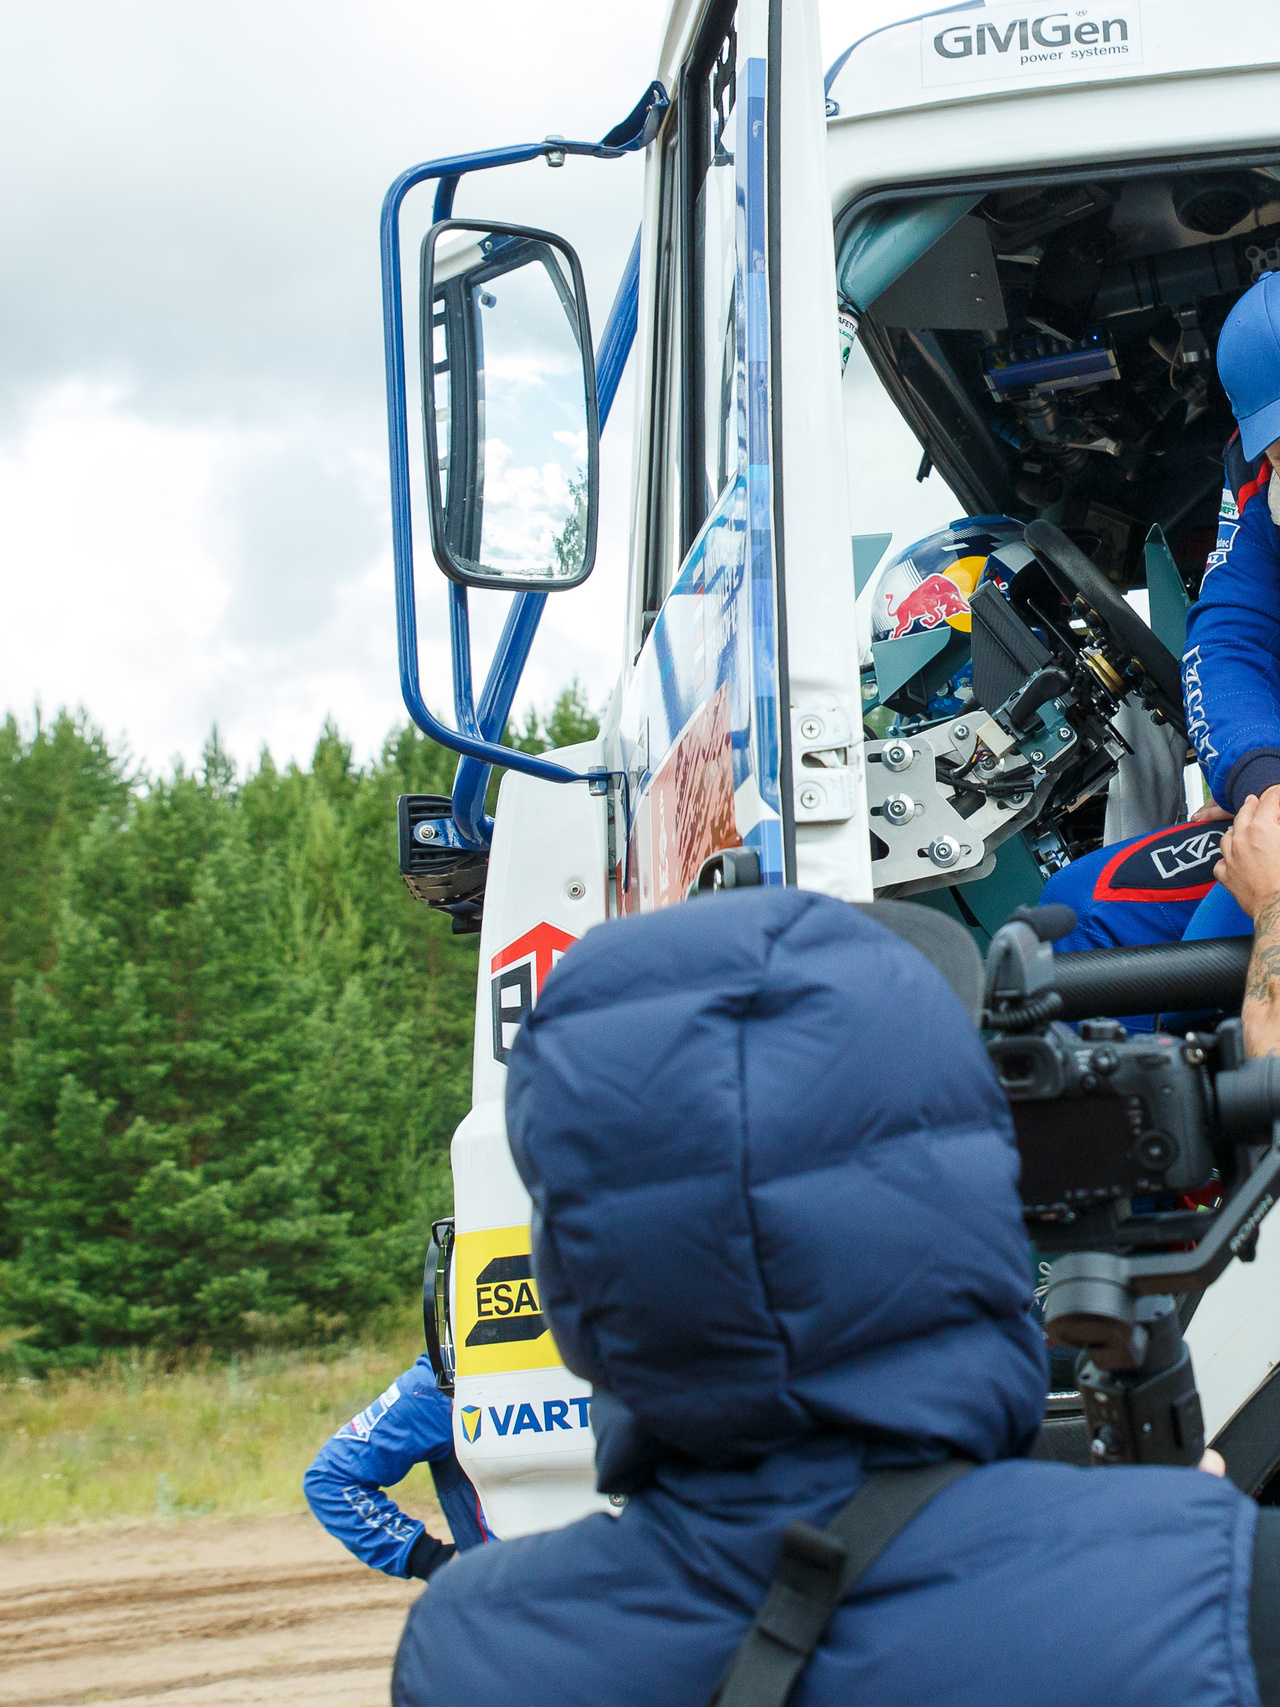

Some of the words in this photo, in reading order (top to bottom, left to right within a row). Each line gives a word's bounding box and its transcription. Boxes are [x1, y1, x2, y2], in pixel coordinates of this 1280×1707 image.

[1020, 51, 1064, 66] power
[1071, 44, 1129, 60] systems
[476, 1282, 543, 1318] ESA
[488, 1396, 593, 1437] VART
